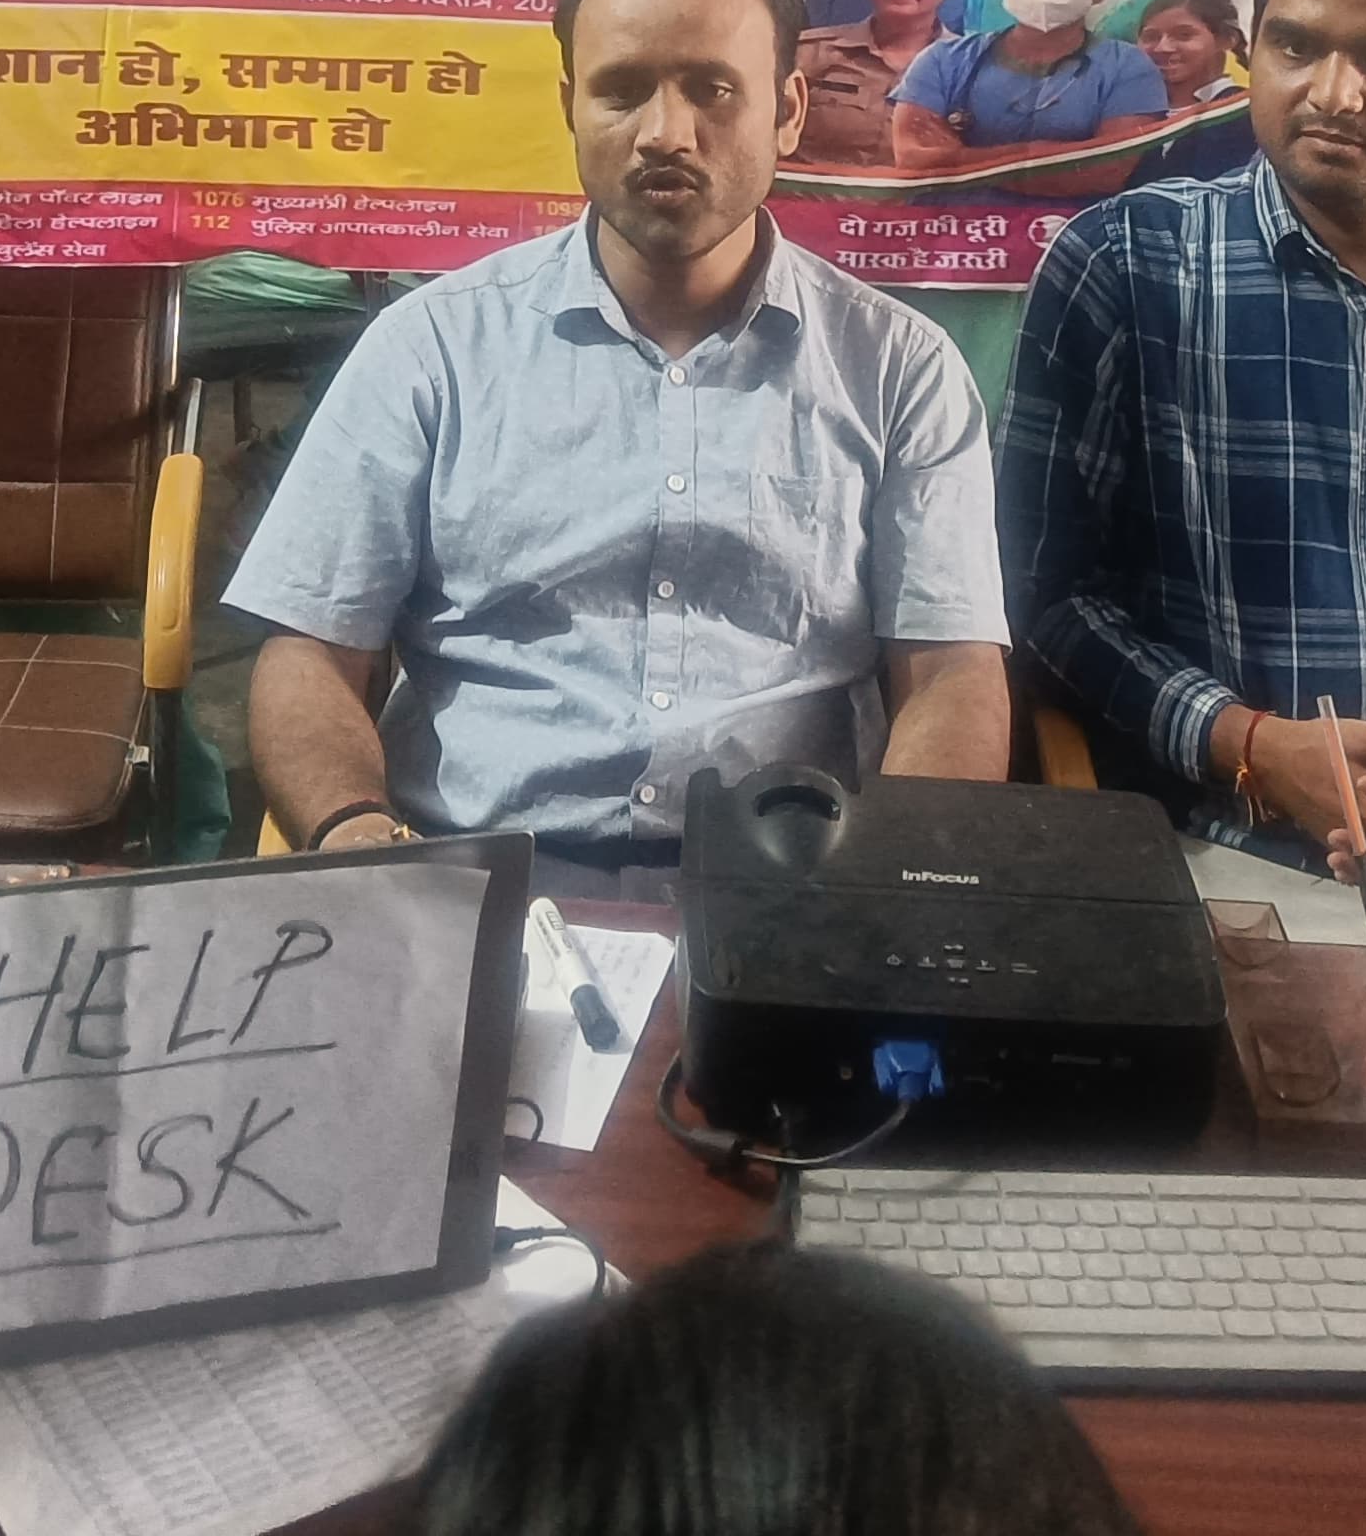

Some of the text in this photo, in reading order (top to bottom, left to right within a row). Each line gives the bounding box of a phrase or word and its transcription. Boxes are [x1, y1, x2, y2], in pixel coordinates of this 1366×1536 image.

[116, 41, 201, 95] हो,
[220, 52, 413, 94] सम्मान
[425, 50, 488, 96] हो
[75, 102, 392, 152] अभिमान हो
[99, 191, 164, 205] लाइन
[191, 191, 244, 208] 1076
[191, 215, 510, 240] 112 पुलिस आपातकालीन सेवा
[838, 213, 867, 237] दो
[923, 215, 960, 237] की
[965, 215, 1010, 243] दूरी
[61, 240, 107, 256] सेवा
[836, 250, 907, 269] मास्क
[911, 247, 931, 268] है
[902, 869, 980, 885] InFocus
